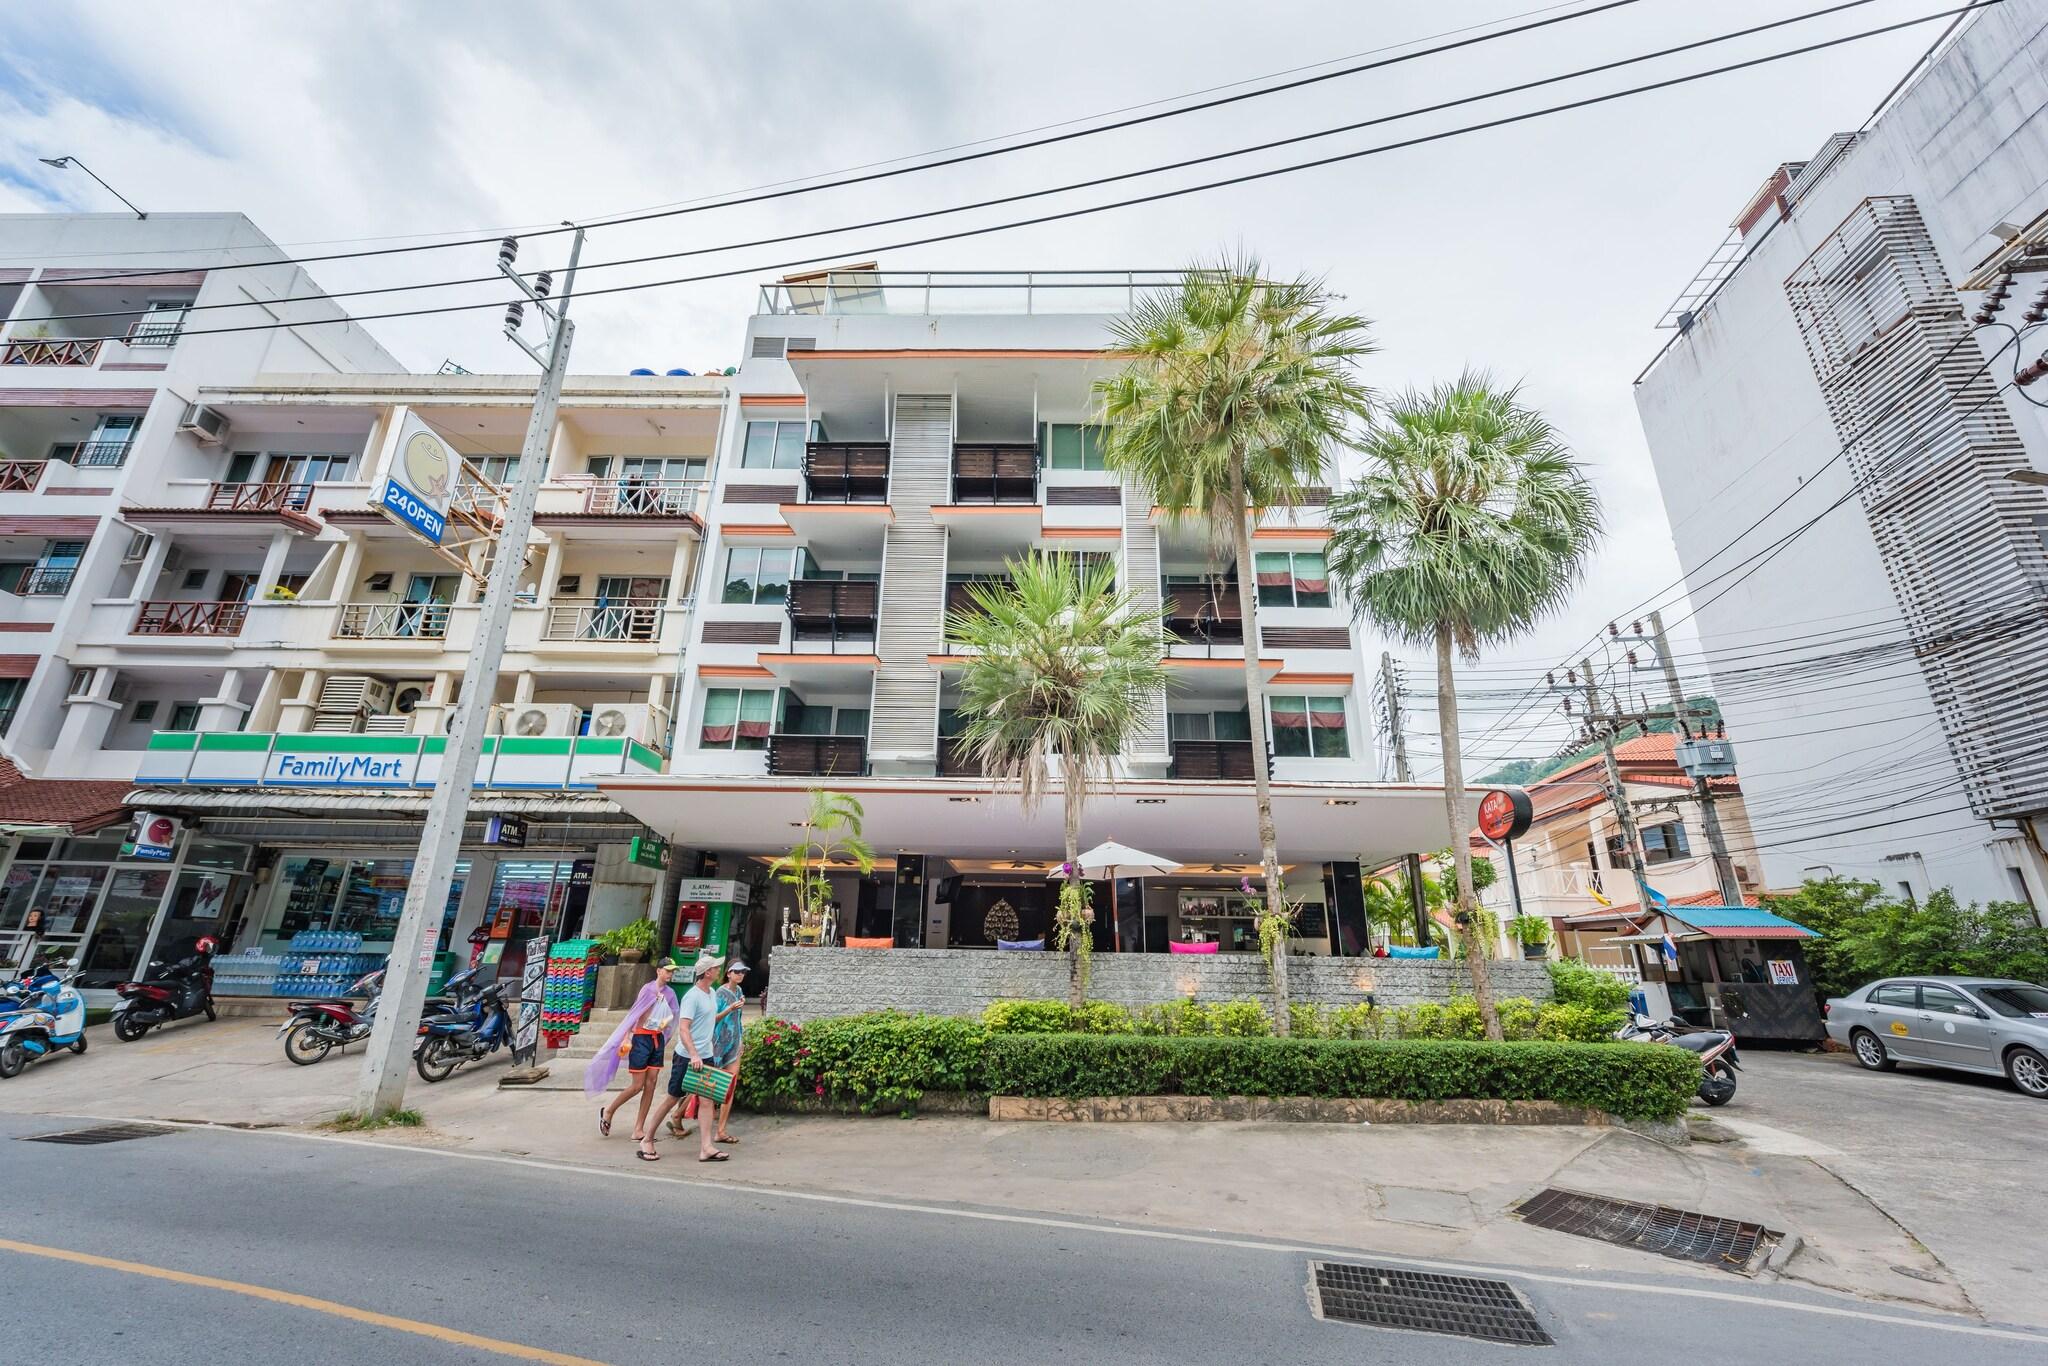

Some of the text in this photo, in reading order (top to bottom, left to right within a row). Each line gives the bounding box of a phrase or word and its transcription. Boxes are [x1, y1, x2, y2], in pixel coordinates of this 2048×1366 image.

[279, 755, 402, 783] FamilyMart
[501, 823, 519, 837] ATM
[137, 846, 171, 857] FamilyMart
[573, 872, 588, 880] ATM
[1772, 963, 1794, 977] TAXI
